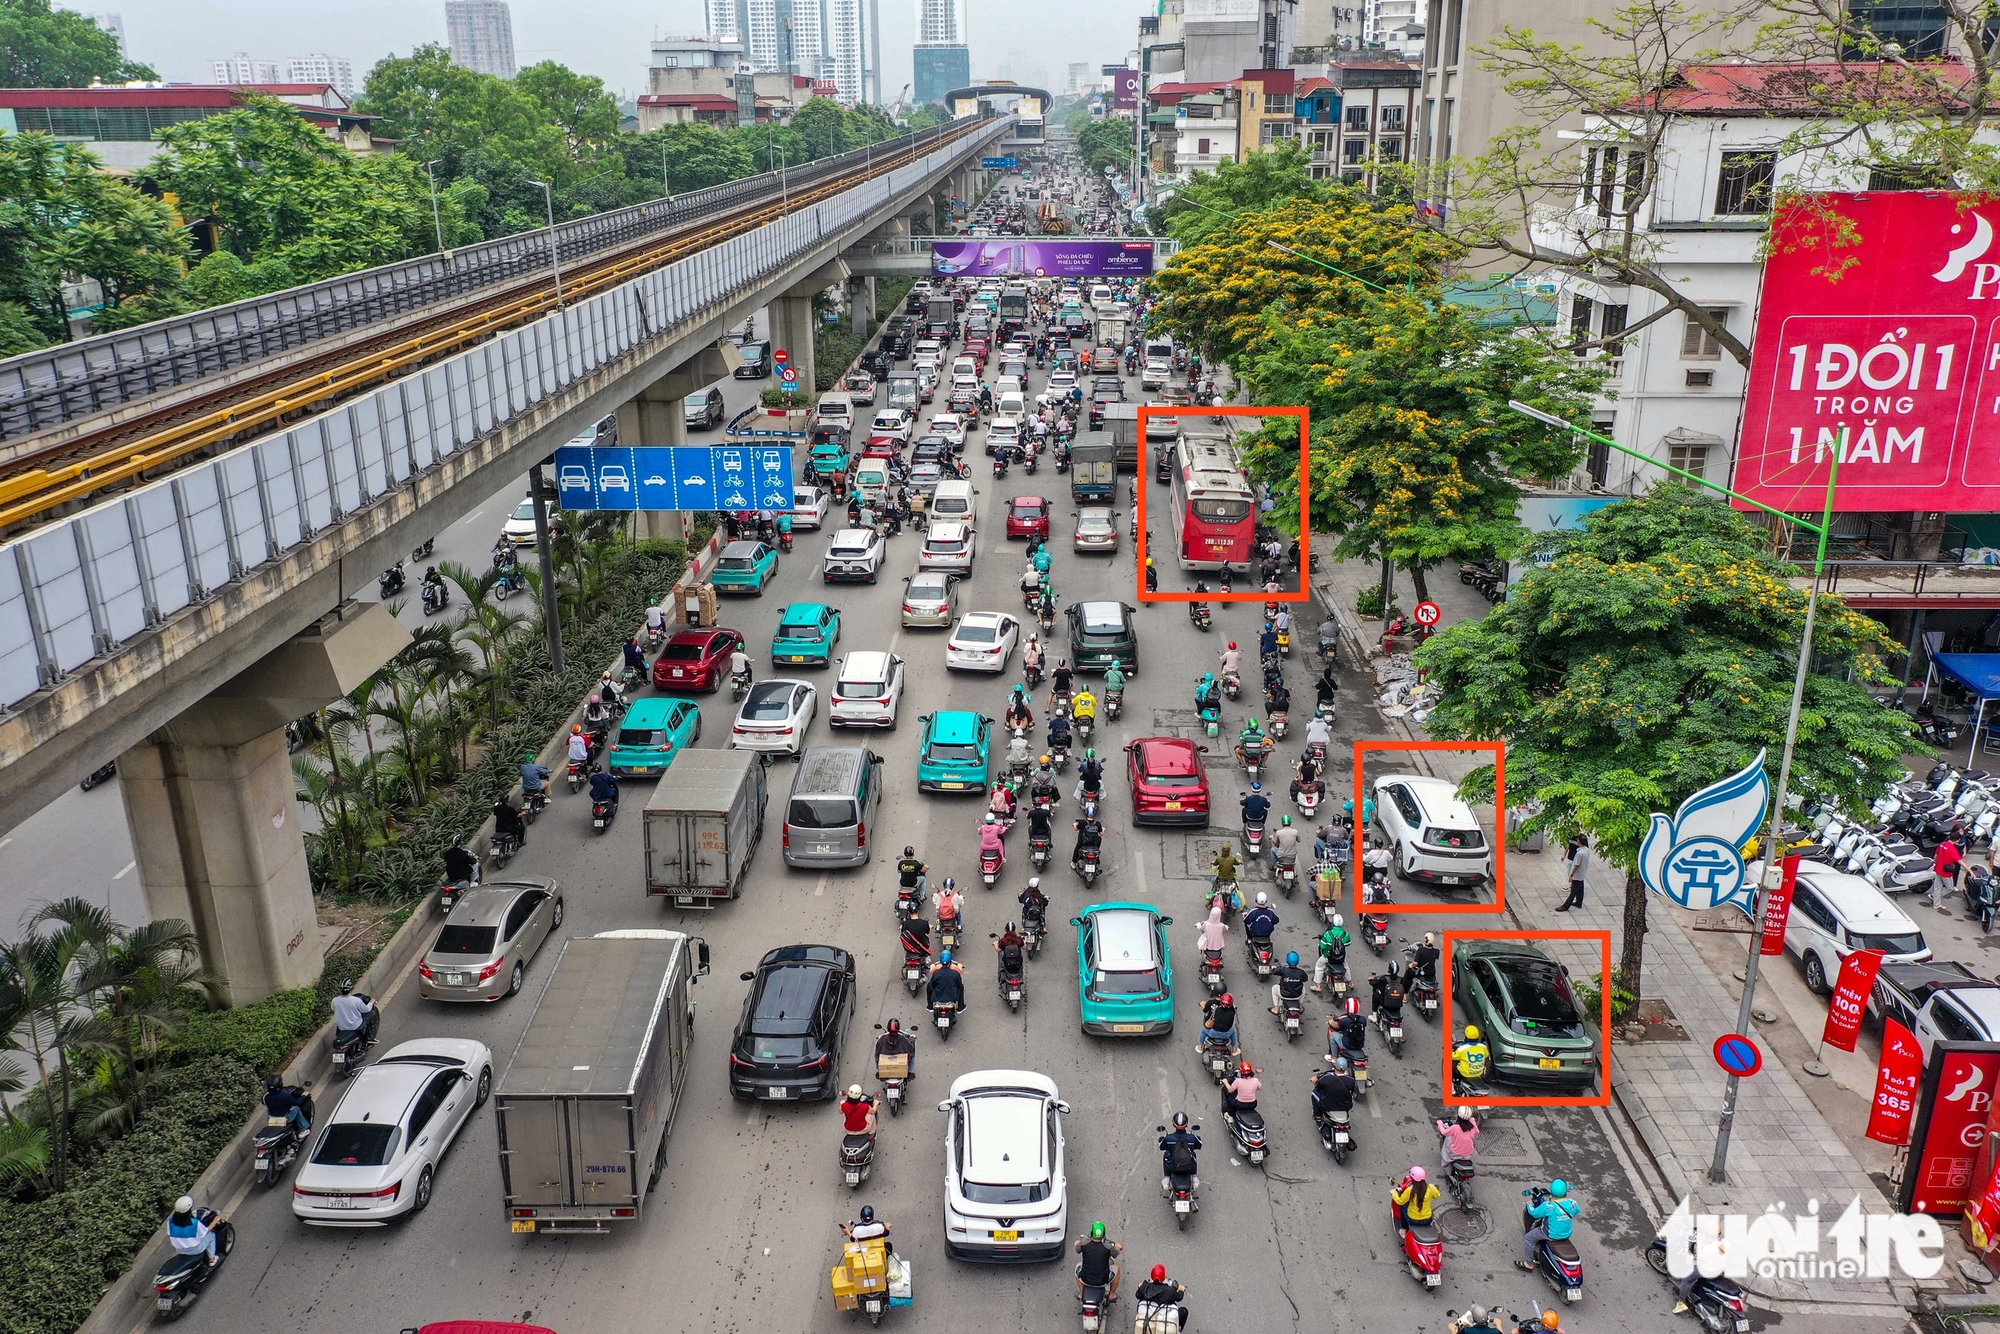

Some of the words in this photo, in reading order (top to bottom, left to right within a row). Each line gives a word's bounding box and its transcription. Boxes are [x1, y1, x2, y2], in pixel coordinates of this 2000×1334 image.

[812, 80, 836, 88] HOTEL
[1789, 344, 1808, 390] 1
[1815, 327, 1926, 390] ĐỔI
[1935, 344, 1955, 390] 1
[1814, 396, 1915, 415] TRONG
[1789, 427, 1803, 464] 1
[1814, 418, 1925, 464] NĂM
[702, 832, 718, 840] 99C
[1767, 902, 1782, 910] GIÁ
[1766, 911, 1785, 920] OÀN
[286, 930, 304, 956] DR25
[1467, 1051, 1484, 1063] be
[1882, 1068, 1890, 1080] 1
[1907, 1076, 1916, 1088] 1
[1884, 1084, 1908, 1096] TRONG
[1878, 1093, 1910, 1112] 365
[1881, 1110, 1901, 1119] NGÀY
[586, 1165, 626, 1173] 29H-878.66
